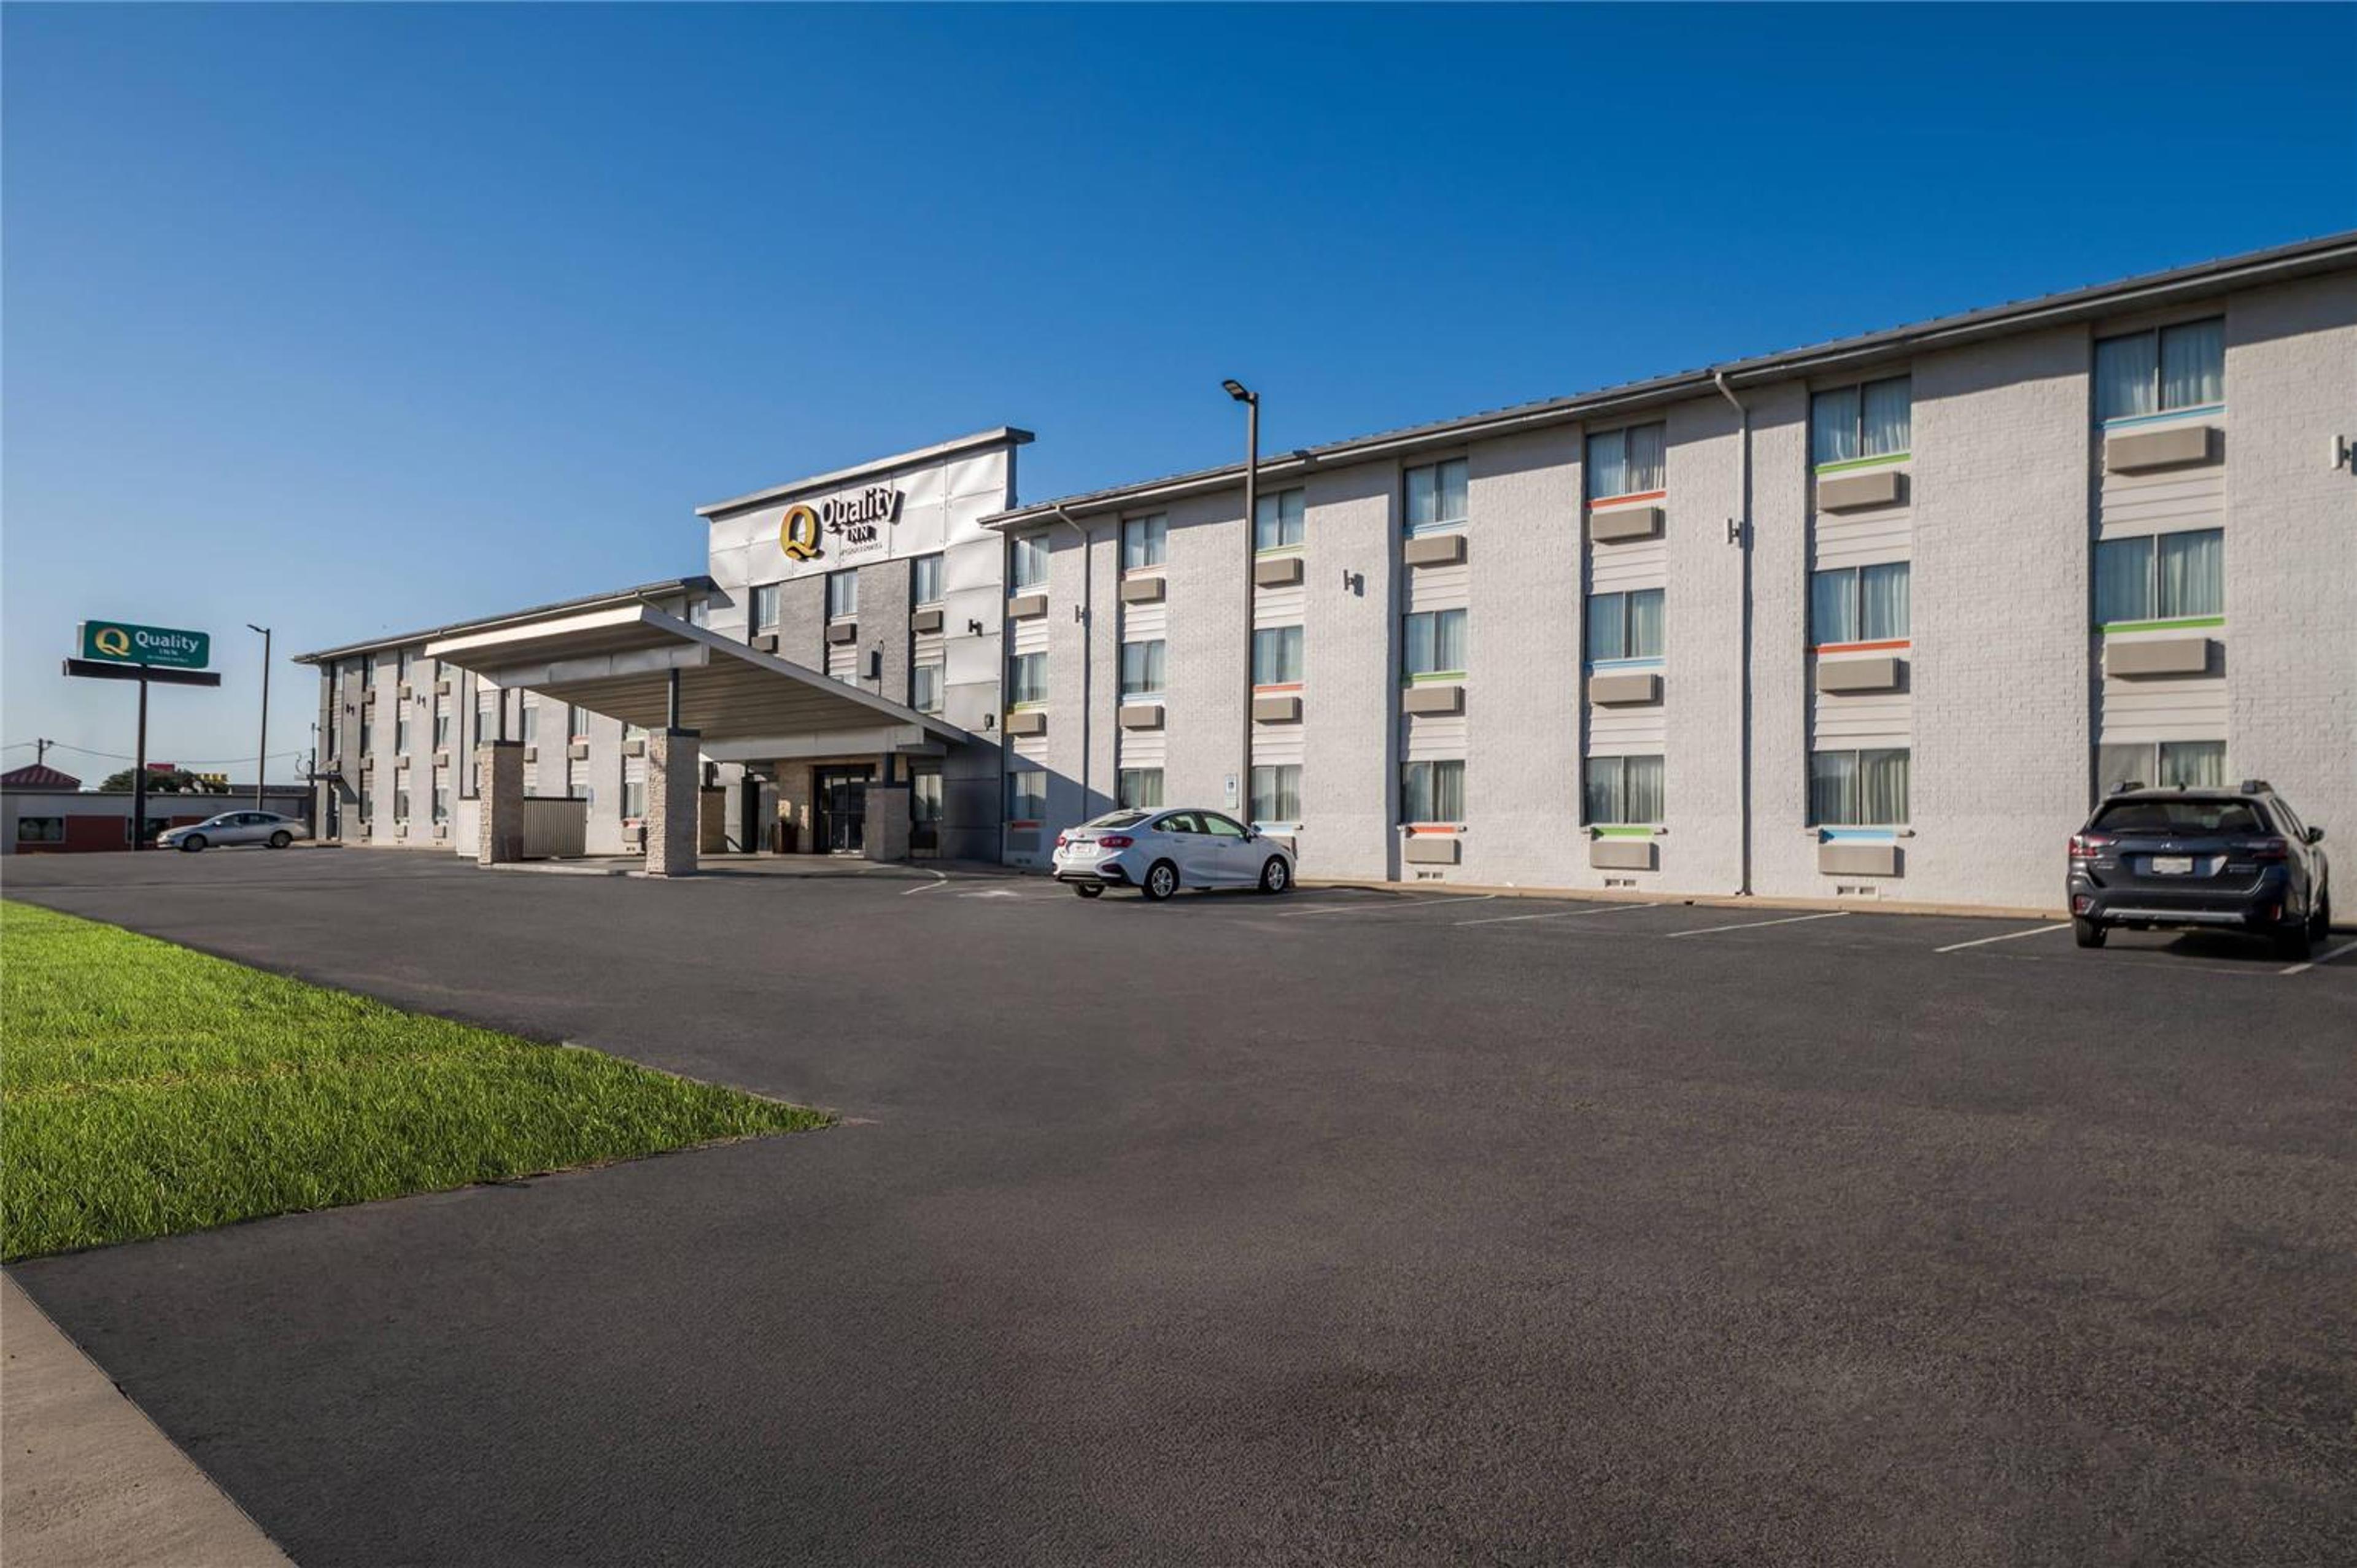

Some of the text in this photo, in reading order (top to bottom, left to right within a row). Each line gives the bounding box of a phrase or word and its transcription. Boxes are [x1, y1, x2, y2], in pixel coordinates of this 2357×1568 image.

[821, 489, 897, 531] Quality
[780, 504, 816, 558] Q
[96, 628, 131, 656] Q
[135, 631, 198, 652] Quality
